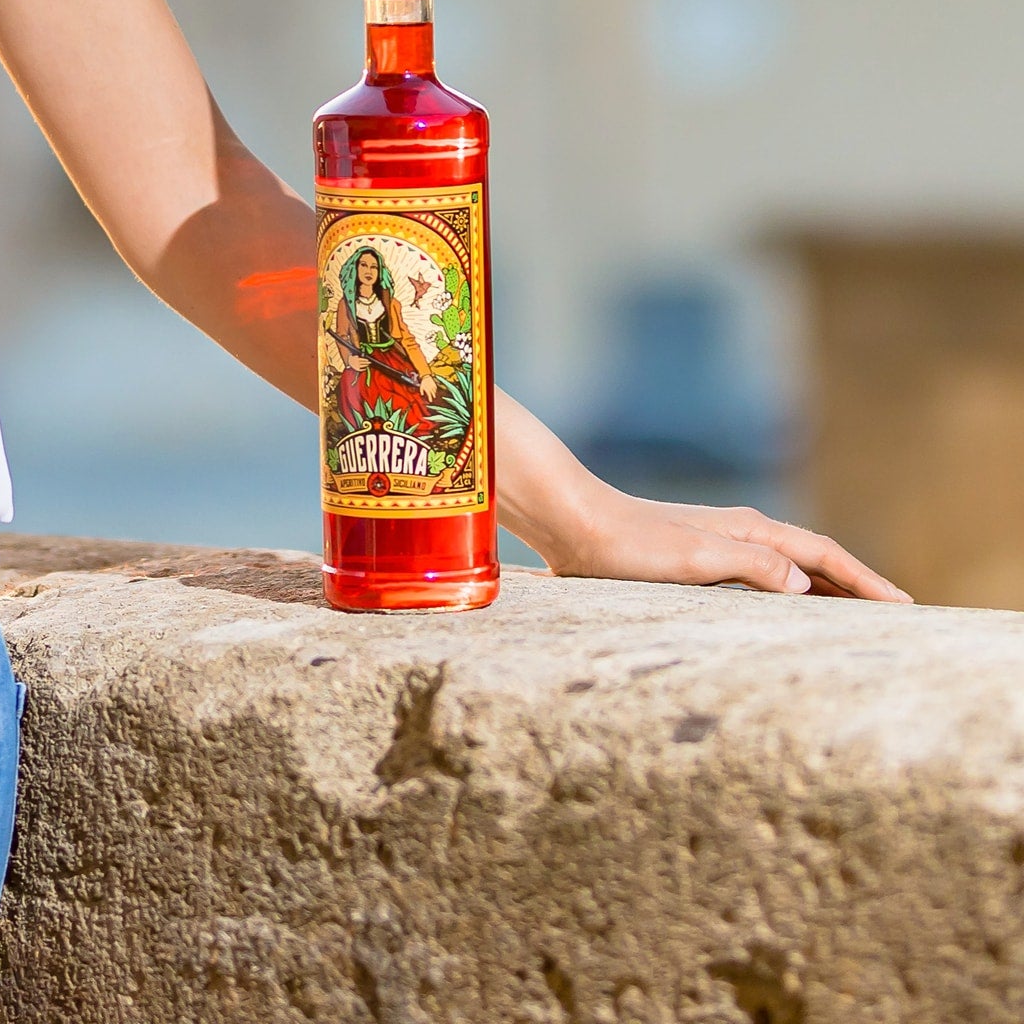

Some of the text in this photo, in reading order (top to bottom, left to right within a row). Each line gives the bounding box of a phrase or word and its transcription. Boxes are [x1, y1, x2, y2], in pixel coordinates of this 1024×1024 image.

[338, 434, 427, 476] GUERRERA
[340, 478, 427, 491] APERITIVO SICILIANO
